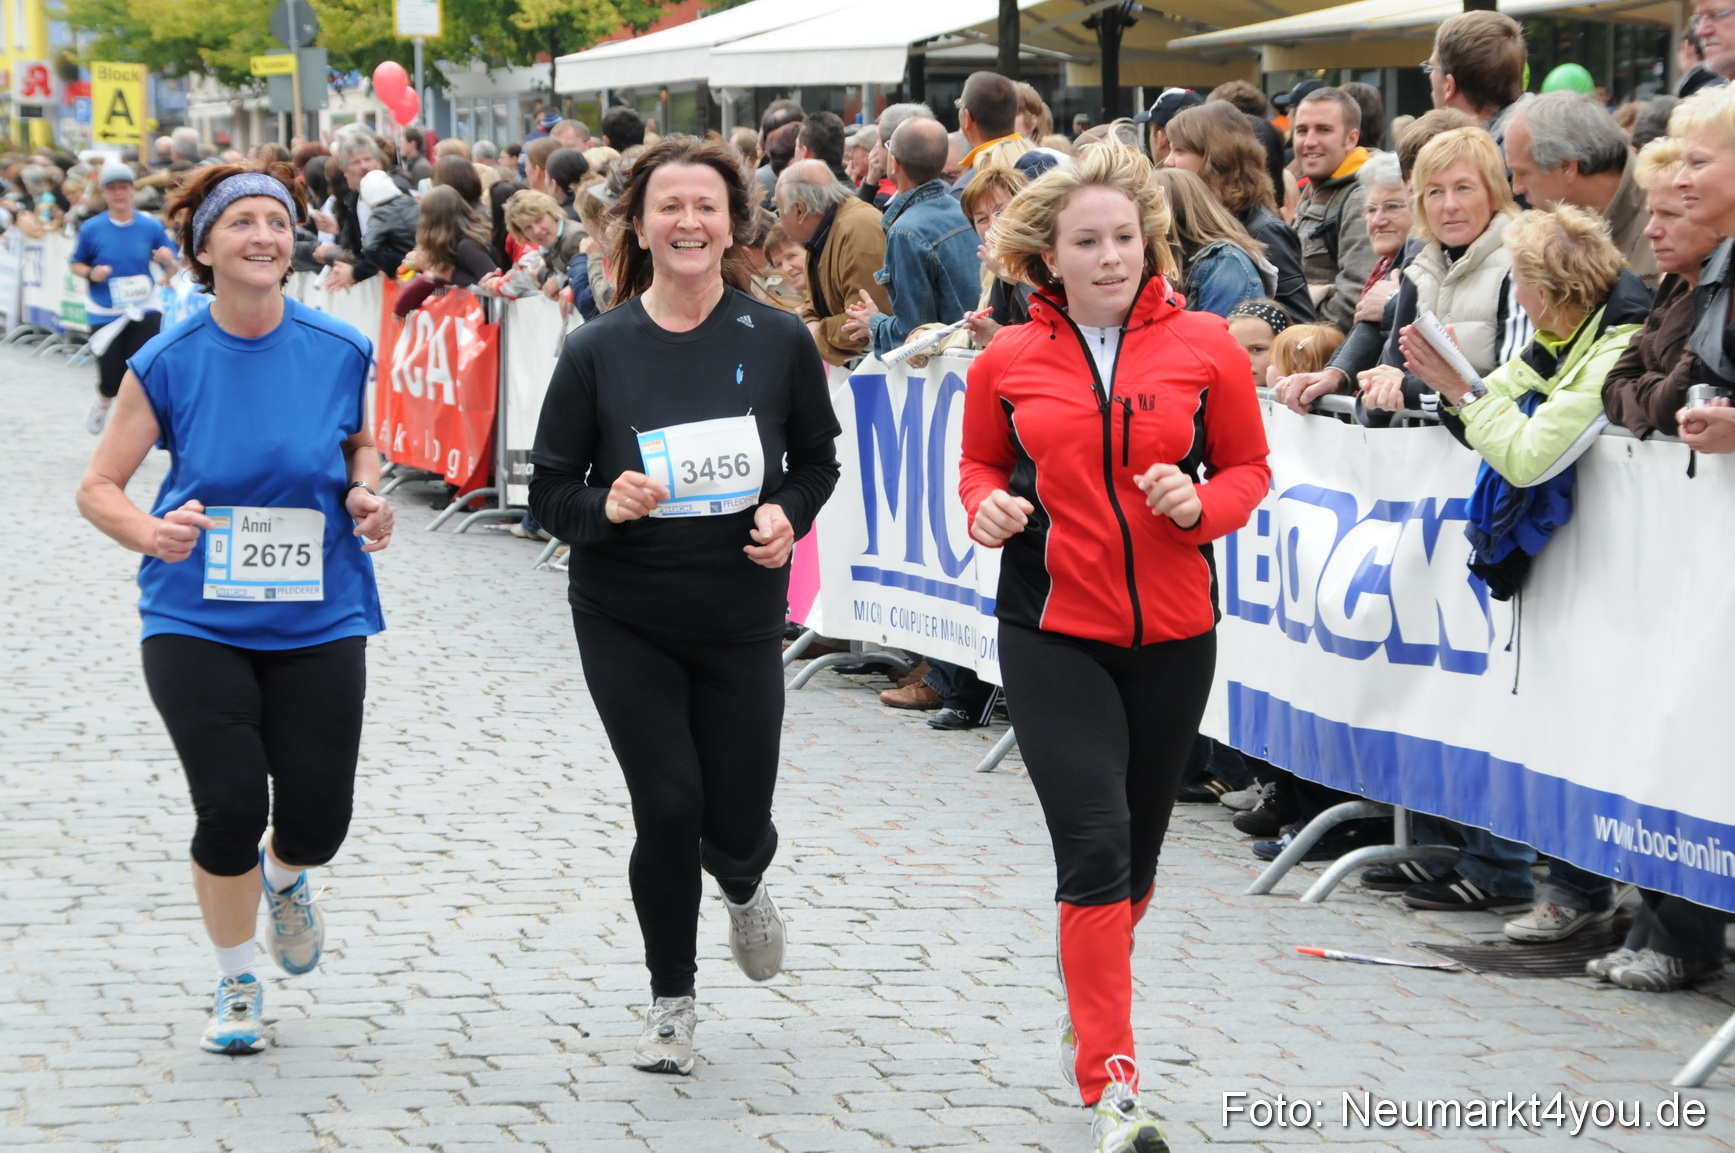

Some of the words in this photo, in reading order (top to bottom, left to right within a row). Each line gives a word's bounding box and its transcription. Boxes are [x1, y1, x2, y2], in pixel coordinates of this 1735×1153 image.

[97, 65, 139, 81] Block
[105, 87, 134, 126] A
[681, 452, 751, 485] 3456
[241, 515, 272, 533] Anni
[241, 543, 312, 568] 2675
[276, 585, 320, 596] PFLEIDERER
[1225, 483, 1496, 676] BOCK
